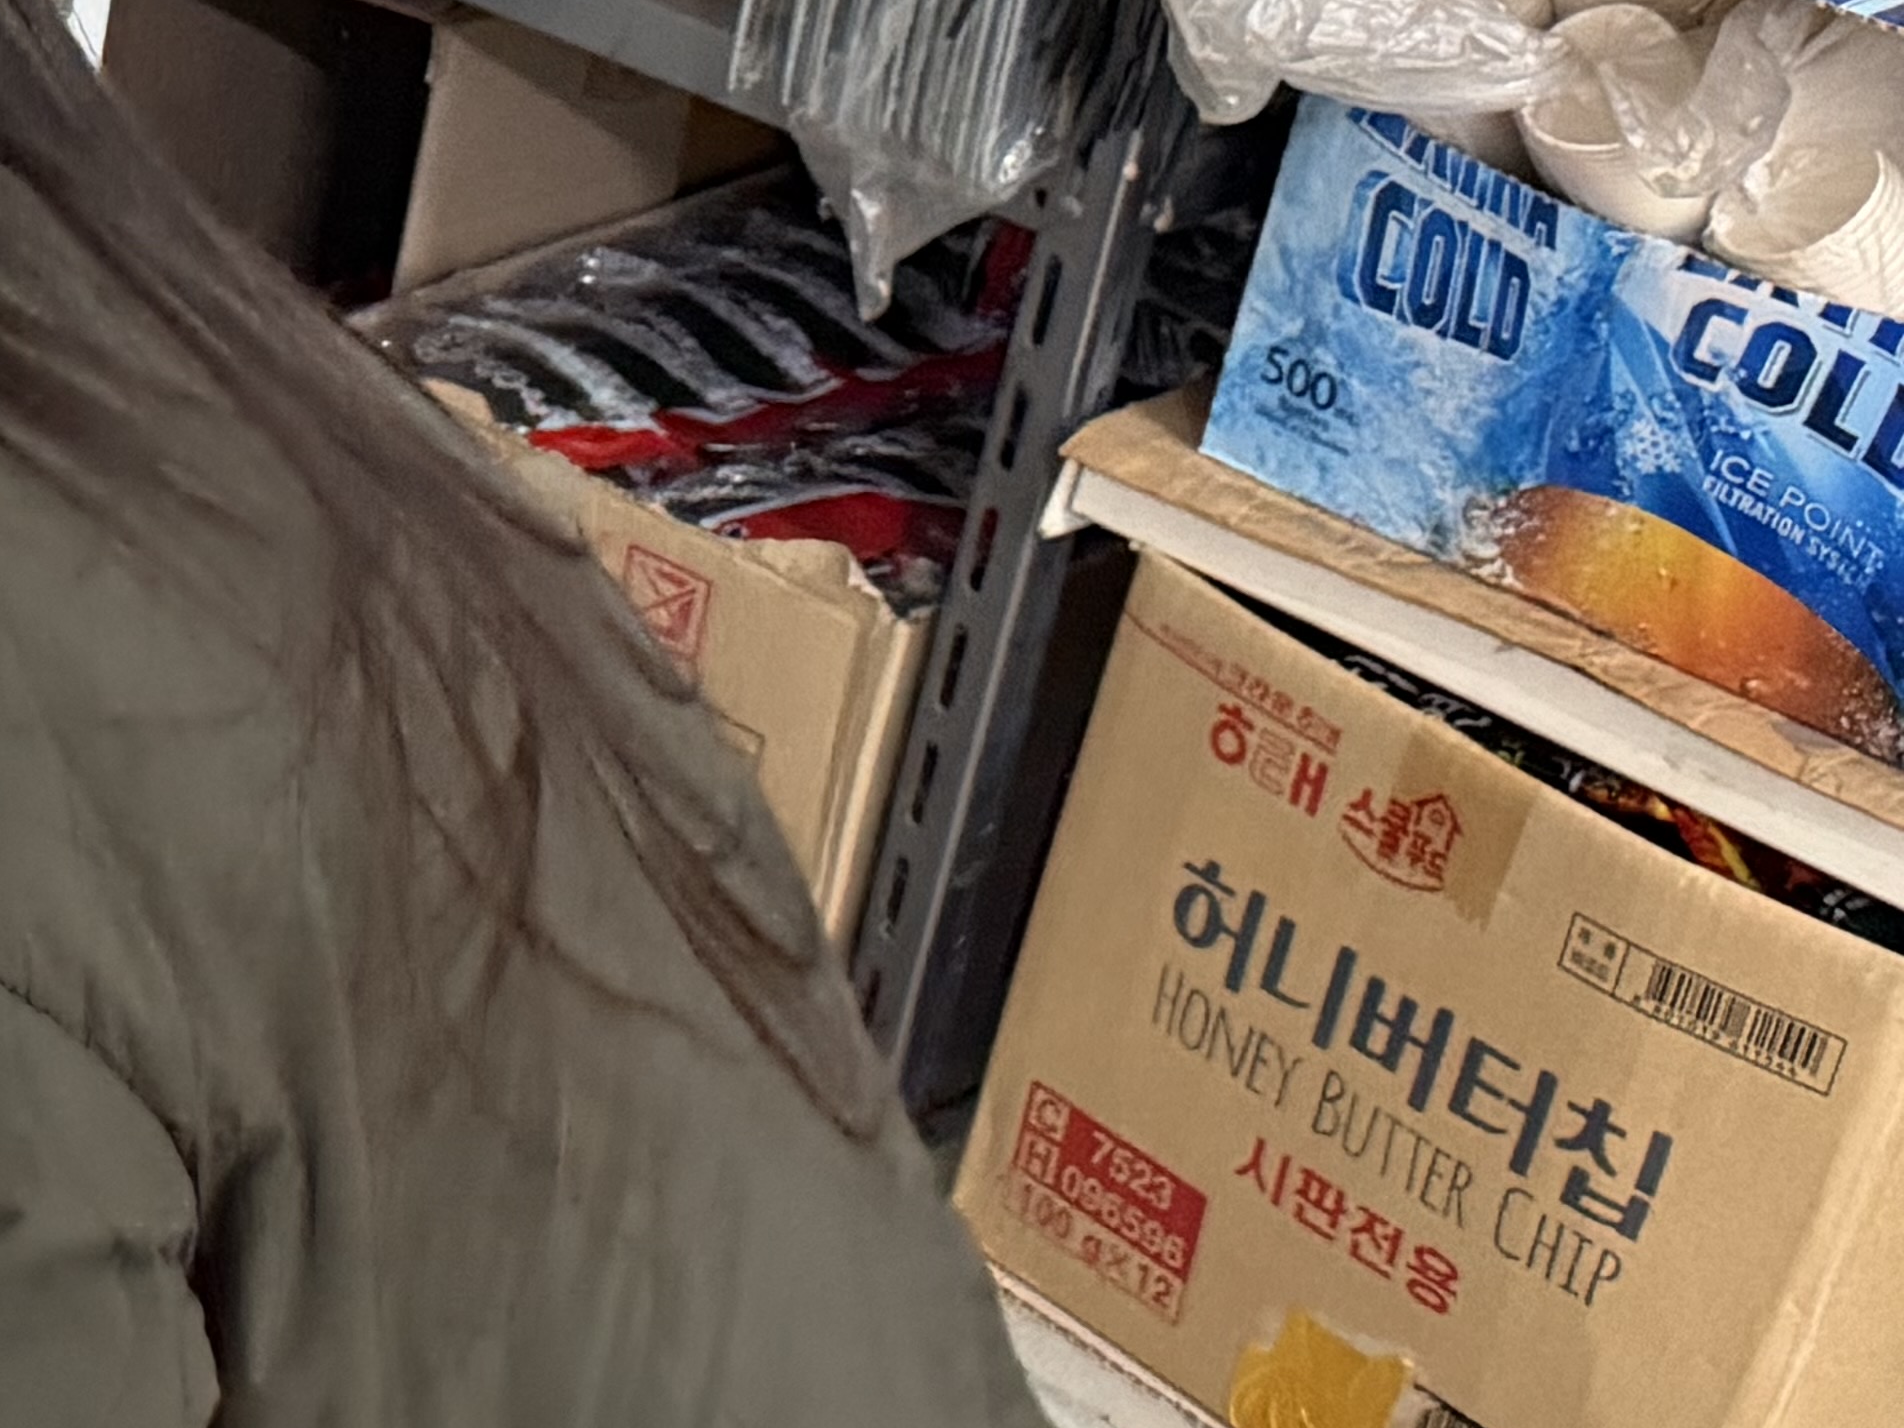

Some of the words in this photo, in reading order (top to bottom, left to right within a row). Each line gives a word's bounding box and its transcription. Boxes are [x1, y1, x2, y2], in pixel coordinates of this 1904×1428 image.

[1352, 173, 1533, 366] COLD
[1259, 344, 1338, 411] 500
[1702, 474, 1806, 550] FILTRATION
[1709, 449, 1775, 498] ICE
[1779, 485, 1887, 571] POINT
[1172, 858, 1675, 1243] 허니버터칩
[1091, 1130, 1177, 1211] 7523
[1151, 962, 1304, 1109] HONEY
[1310, 1068, 1475, 1230] BUTTER
[1492, 1186, 1623, 1309] CHIP
[1019, 1180, 1073, 1240] 100
[1233, 1136, 1461, 1317] 시판전용
